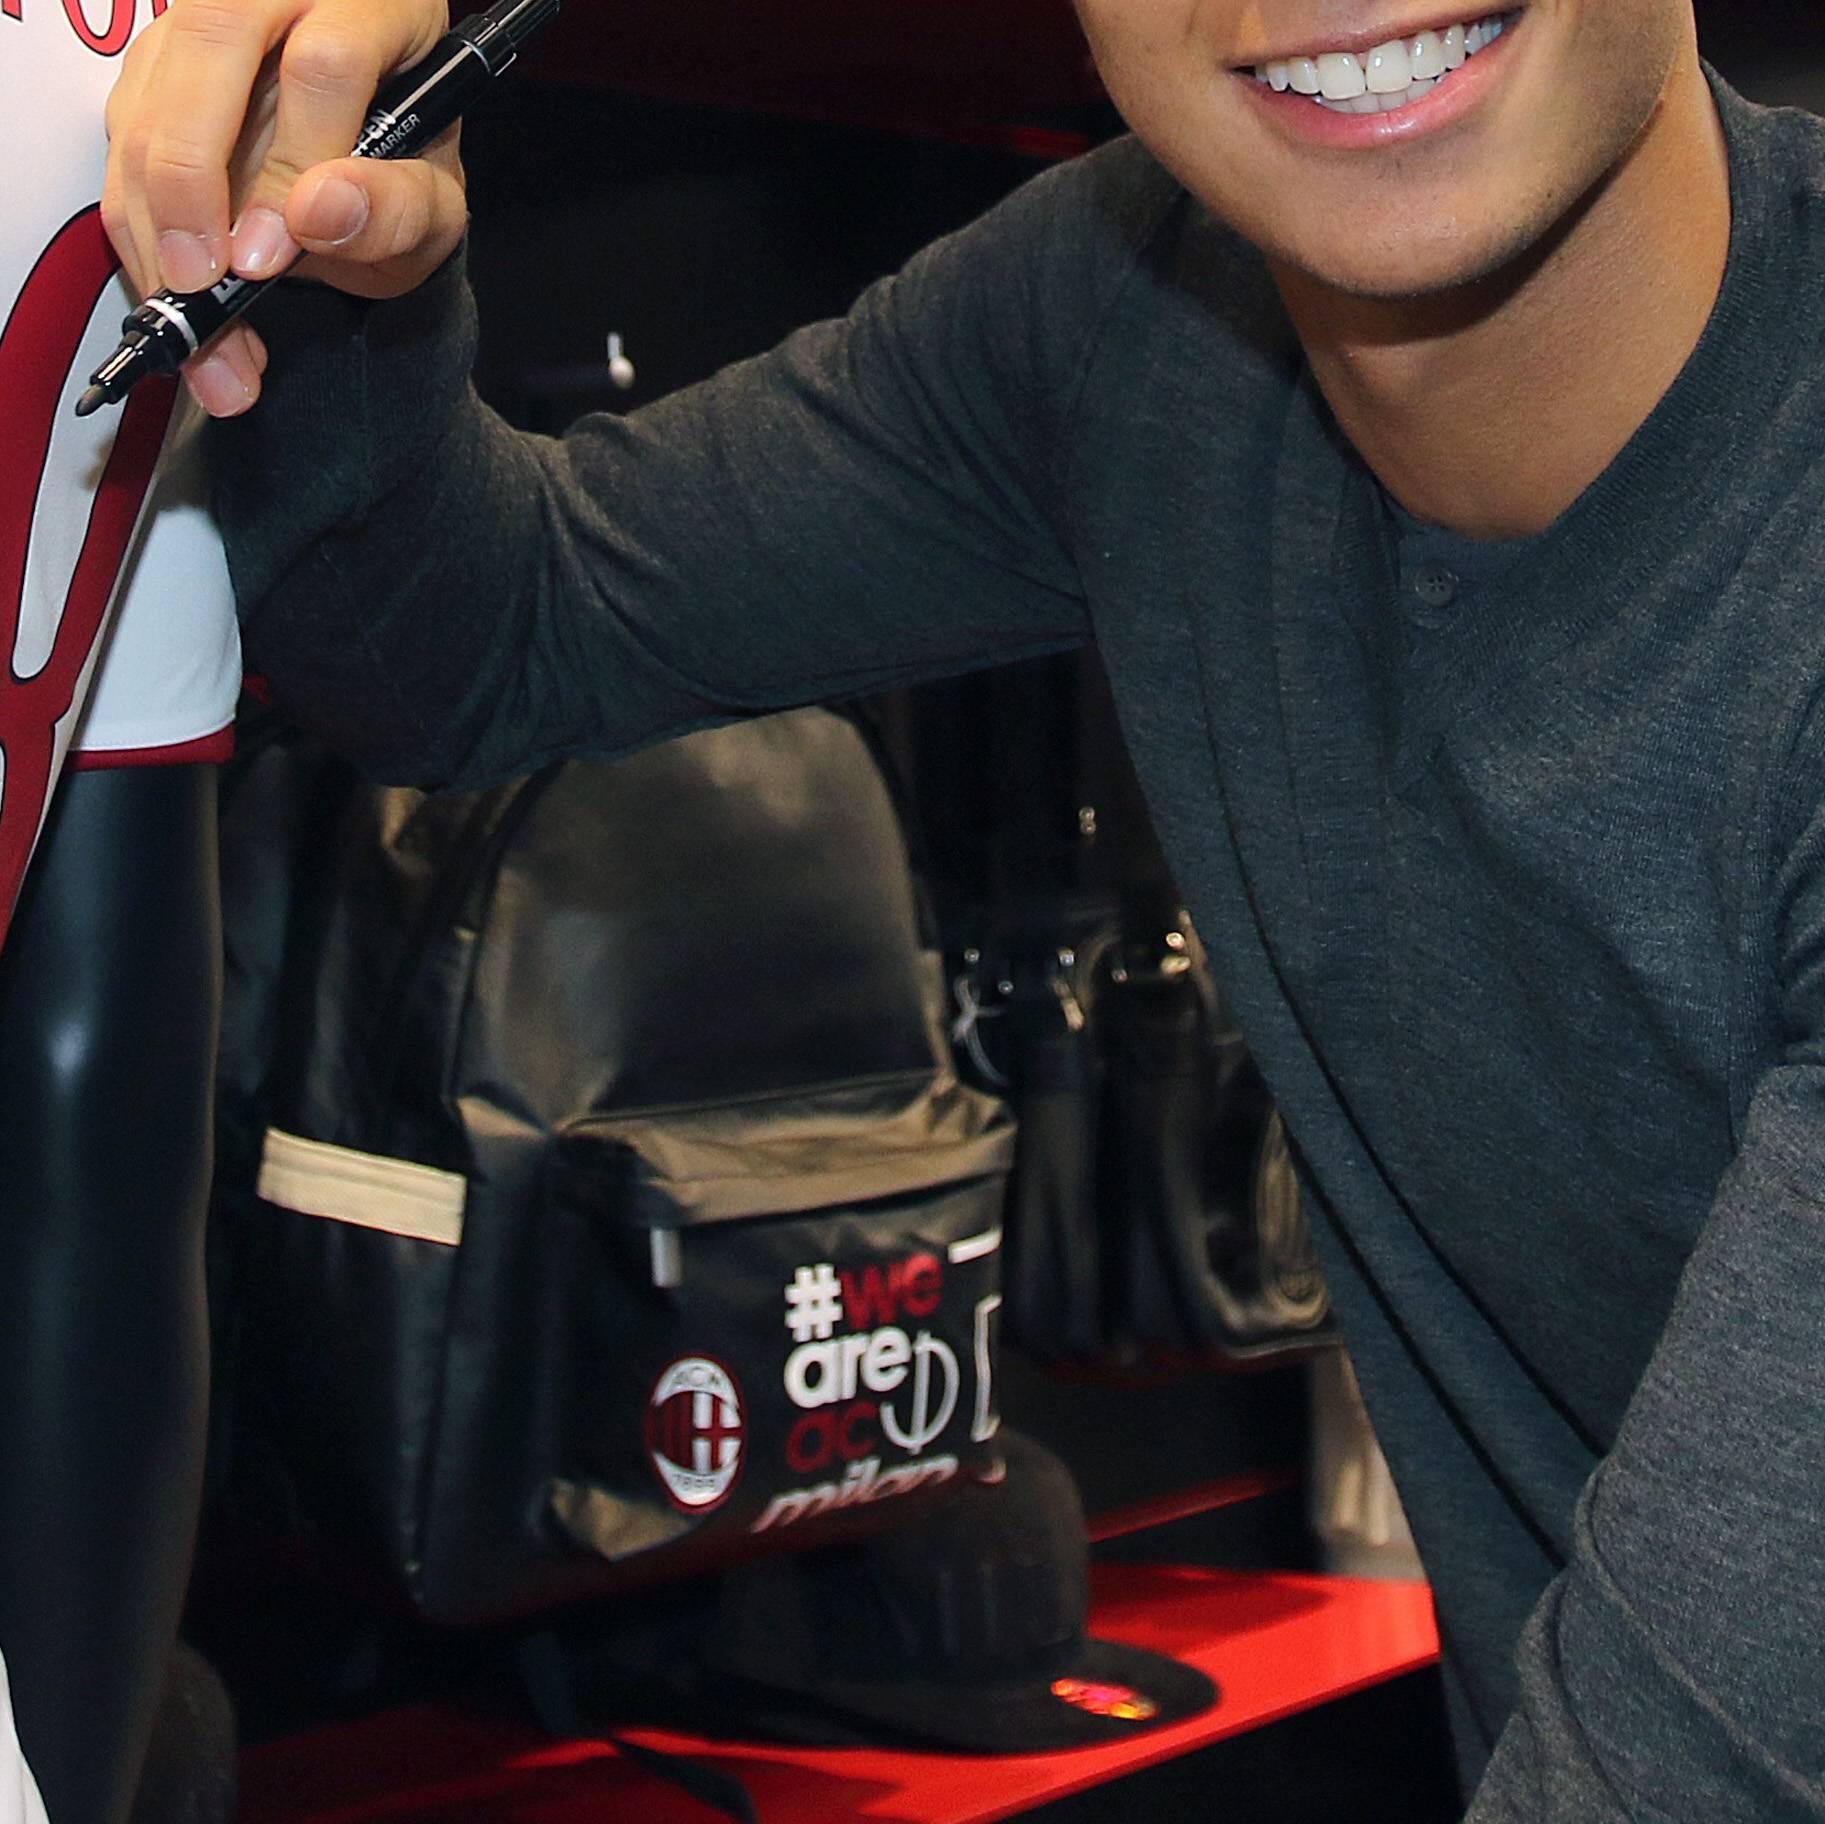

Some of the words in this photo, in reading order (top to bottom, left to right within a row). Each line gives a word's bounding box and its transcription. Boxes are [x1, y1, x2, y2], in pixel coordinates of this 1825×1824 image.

[784, 1251, 945, 1343] #we
[784, 1326, 913, 1409] are
[786, 1401, 879, 1474] ac
[752, 1456, 959, 1534] milan
